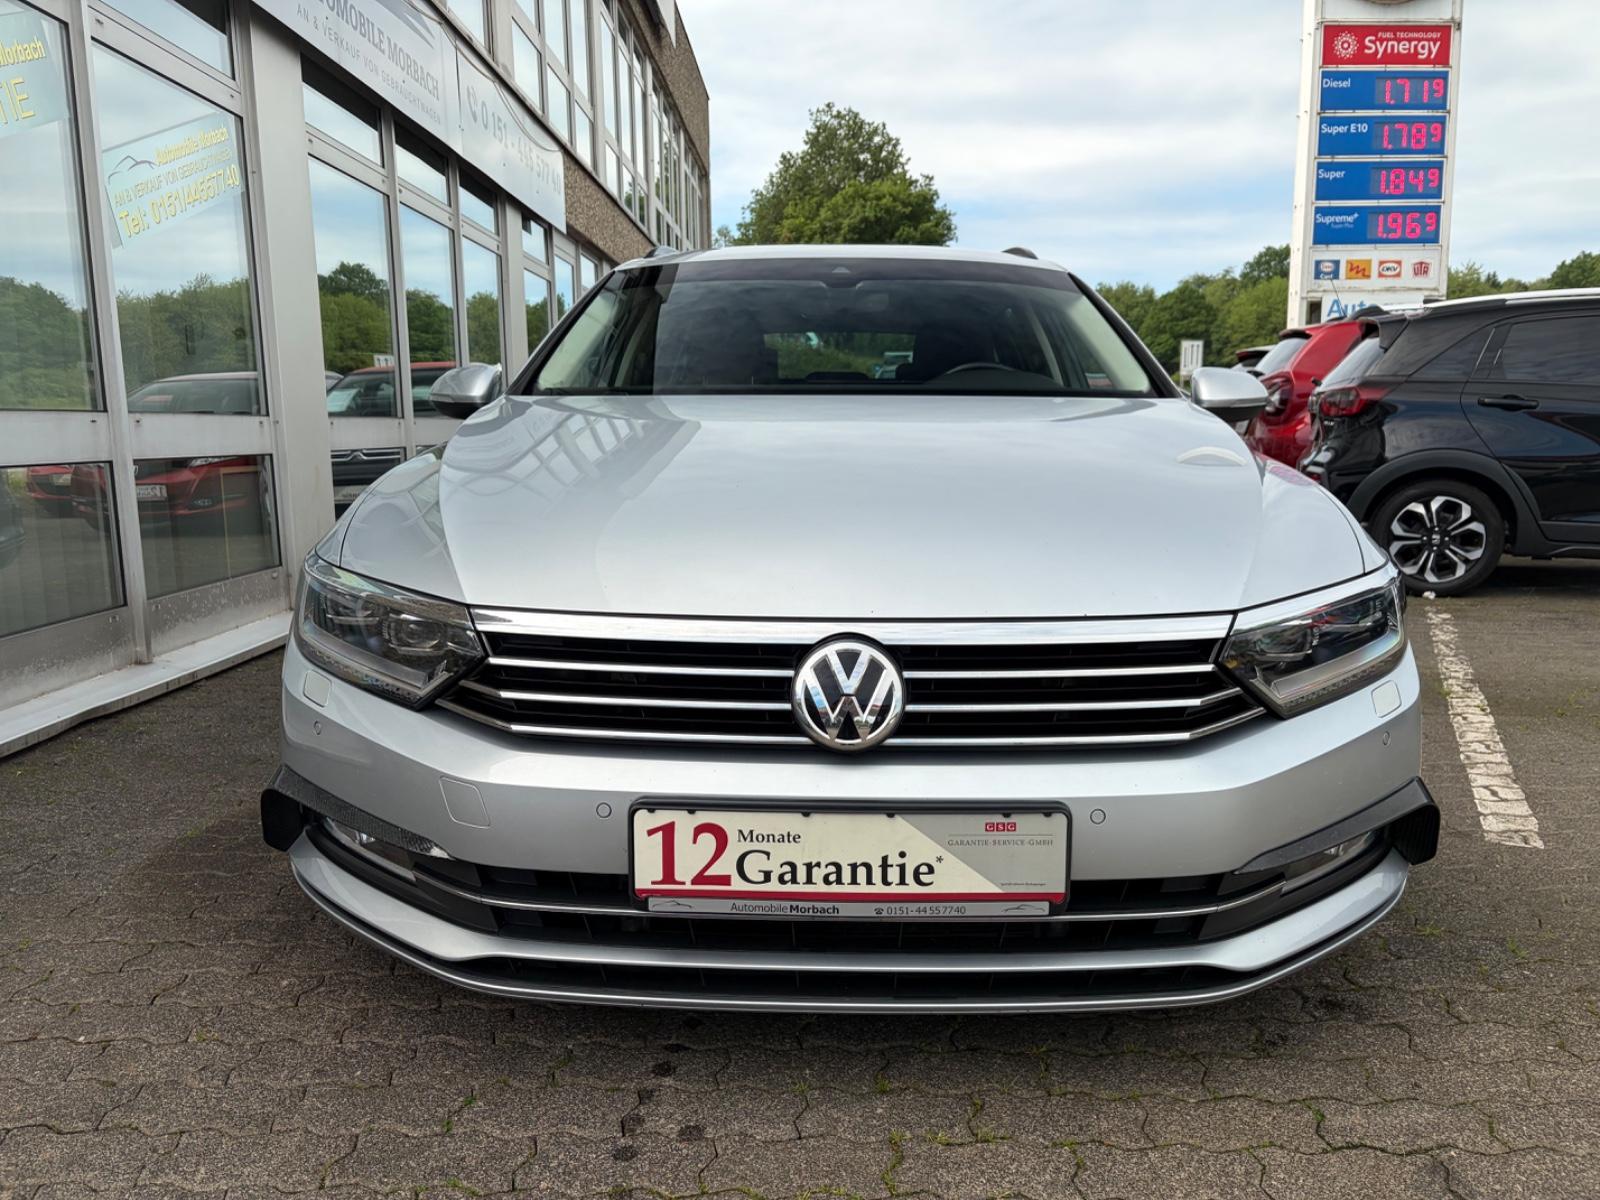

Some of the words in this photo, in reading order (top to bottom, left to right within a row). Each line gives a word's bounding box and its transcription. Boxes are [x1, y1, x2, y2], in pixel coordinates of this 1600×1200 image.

[296, 4, 309, 23] AN
[322, 20, 361, 59] VERKAUF
[318, 0, 386, 55] OMOBILE
[387, 36, 440, 102] MORBACH
[1364, 36, 1441, 59] Synergy
[1322, 78, 1351, 88] Diesel
[1385, 78, 1444, 105] 1.719
[1321, 123, 1348, 136] Super
[1350, 123, 1368, 133] E10
[1383, 123, 1443, 150] 1.789
[155, 138, 199, 166] Automobile
[1318, 169, 1346, 180] Super
[1381, 168, 1440, 195] 1.849
[1378, 212, 1437, 239] 1.969
[737, 829, 801, 844] Monate
[985, 823, 1016, 832] GSG
[646, 820, 732, 886] 12
